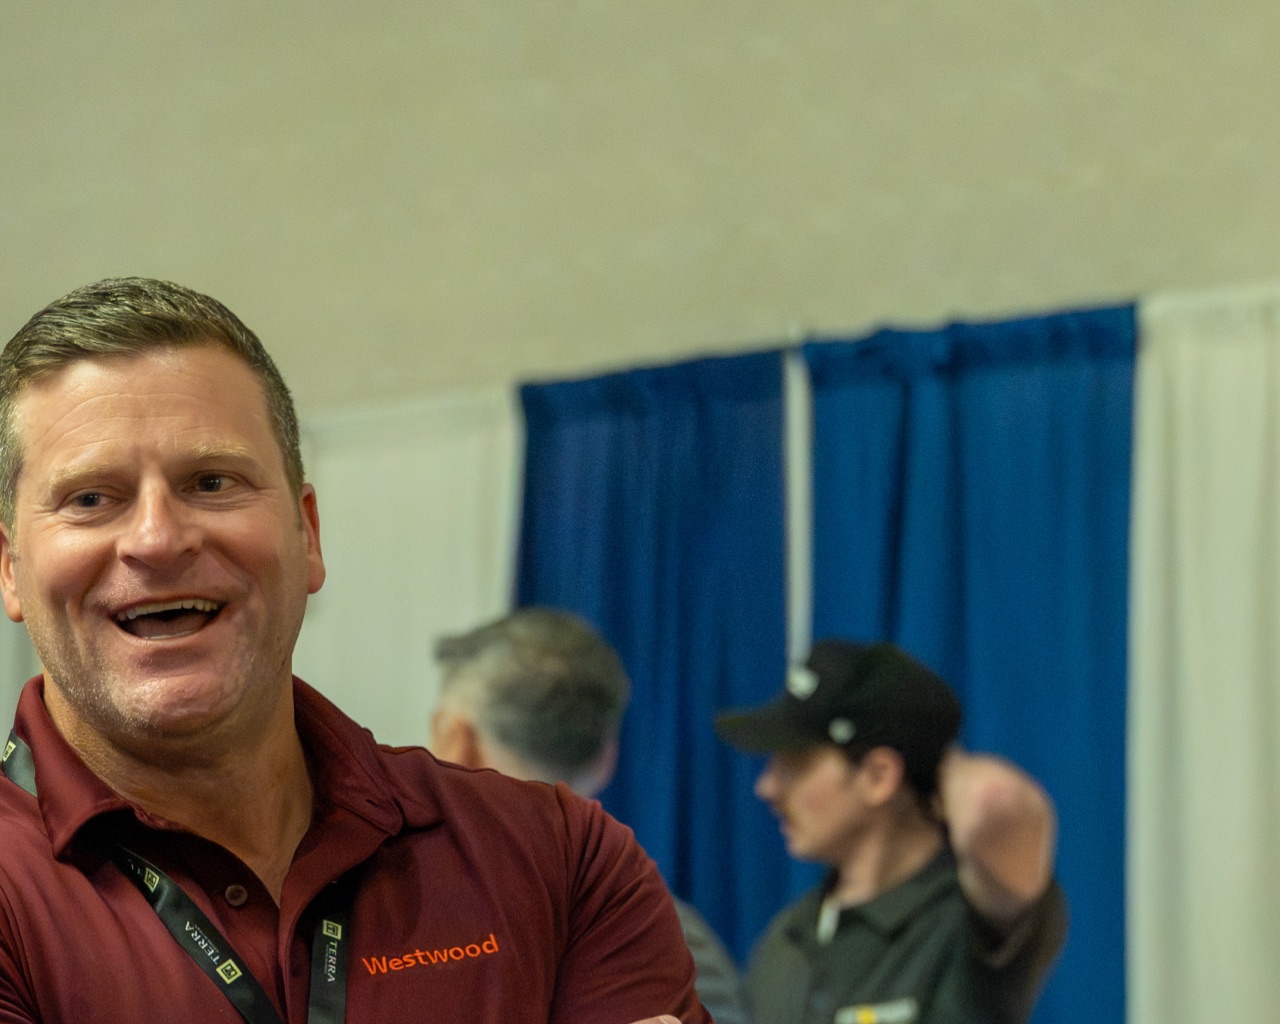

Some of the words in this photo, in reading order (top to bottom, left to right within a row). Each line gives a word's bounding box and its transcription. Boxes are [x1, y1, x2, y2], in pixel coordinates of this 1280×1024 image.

[185, 921, 220, 965] TERRA
[327, 940, 338, 982] TERRA
[361, 933, 499, 975] Westwood
